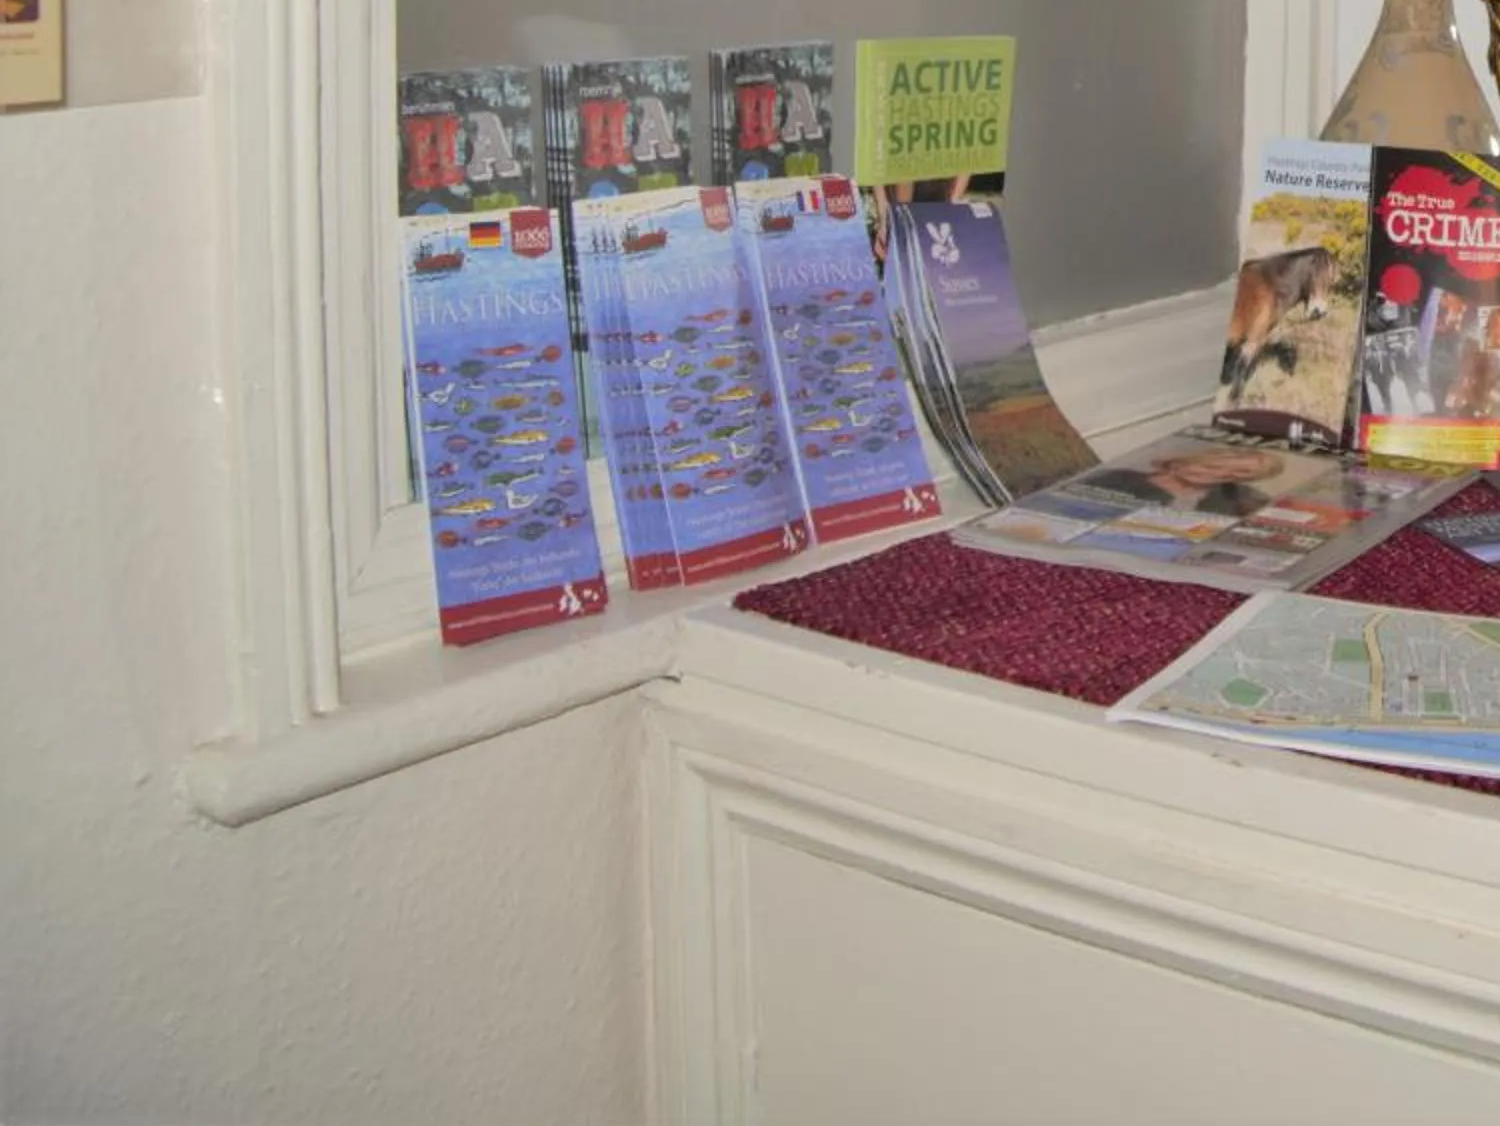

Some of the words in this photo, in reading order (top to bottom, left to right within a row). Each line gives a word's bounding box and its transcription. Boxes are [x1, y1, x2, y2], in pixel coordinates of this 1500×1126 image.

[889, 58, 1004, 96] ACTIVE
[889, 93, 1001, 122] HASTINGS
[888, 118, 998, 156] SPRING
[1264, 169, 1313, 187] Nature
[1387, 192, 1416, 207] The
[1418, 194, 1456, 210] True
[412, 286, 564, 325] HASTINGS
